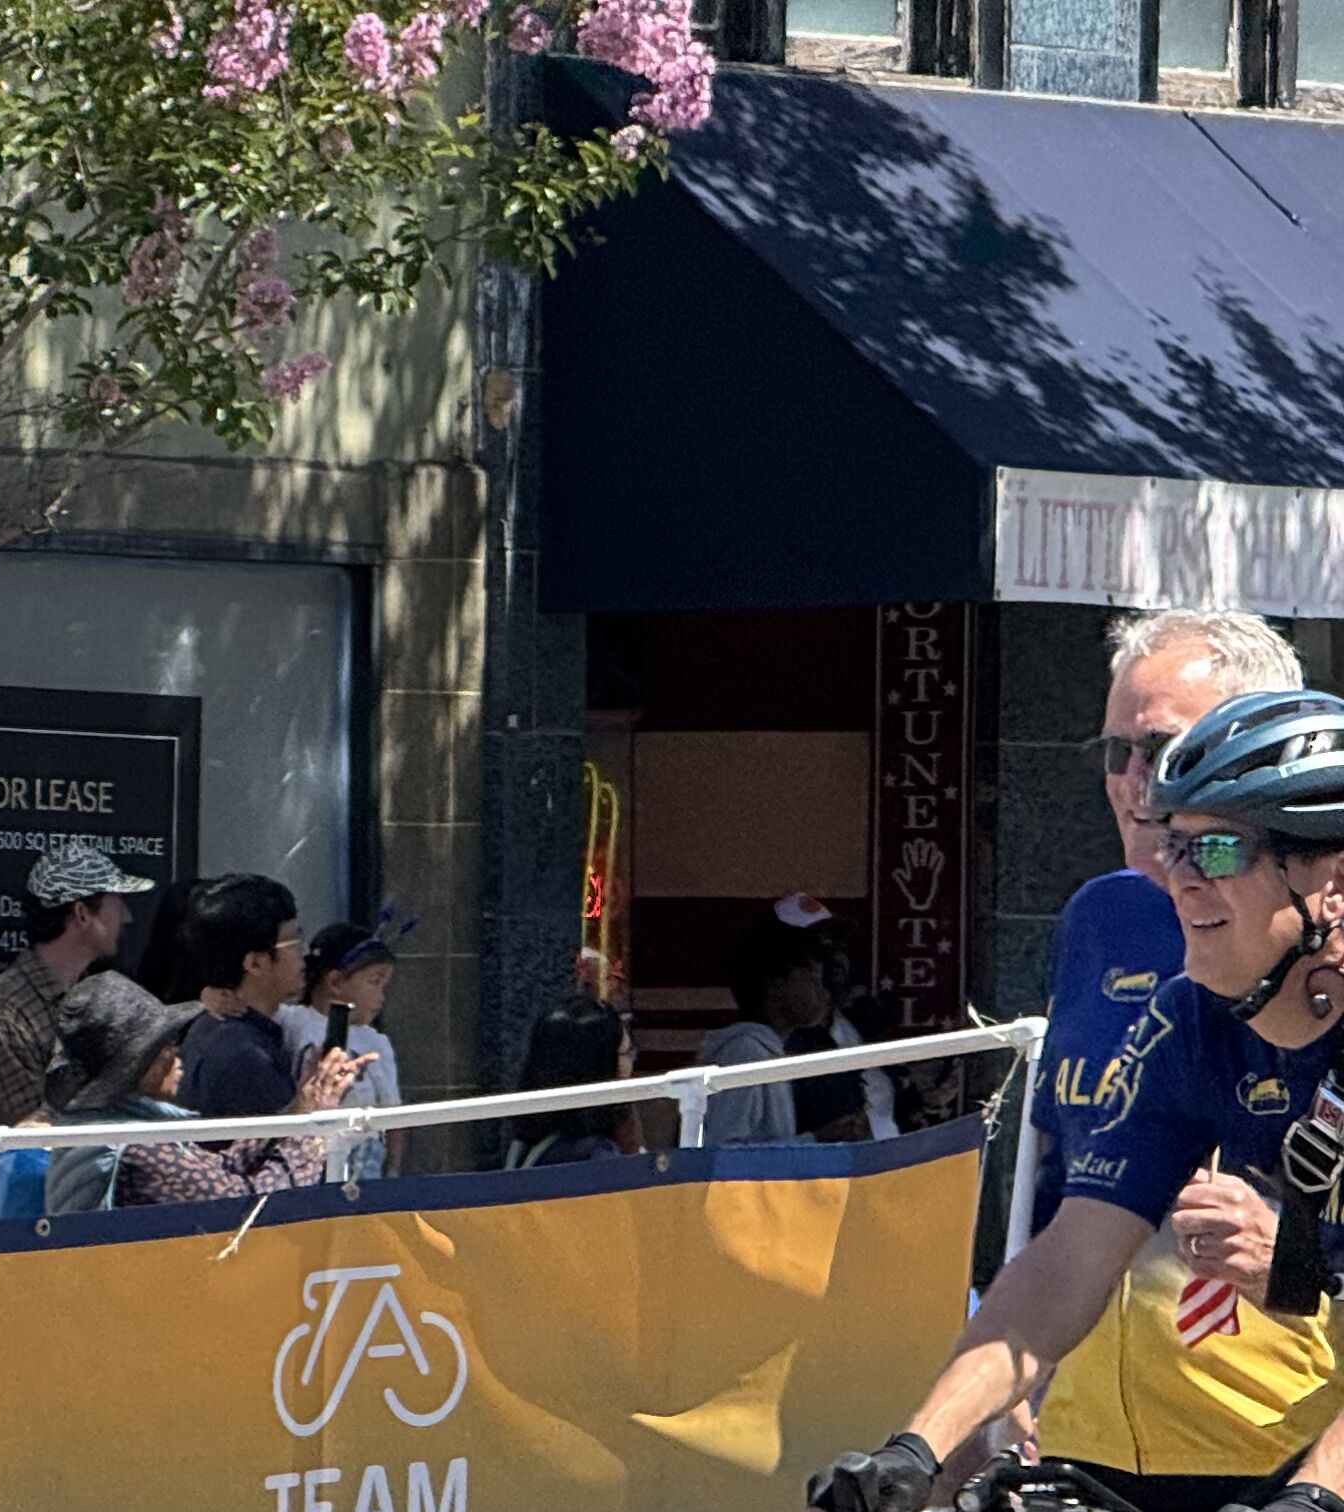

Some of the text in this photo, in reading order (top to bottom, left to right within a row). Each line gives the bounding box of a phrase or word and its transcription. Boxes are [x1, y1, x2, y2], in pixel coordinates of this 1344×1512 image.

[35, 778, 114, 814] LEASE
[25, 832, 45, 851] SQ
[119, 836, 165, 855] SPACE
